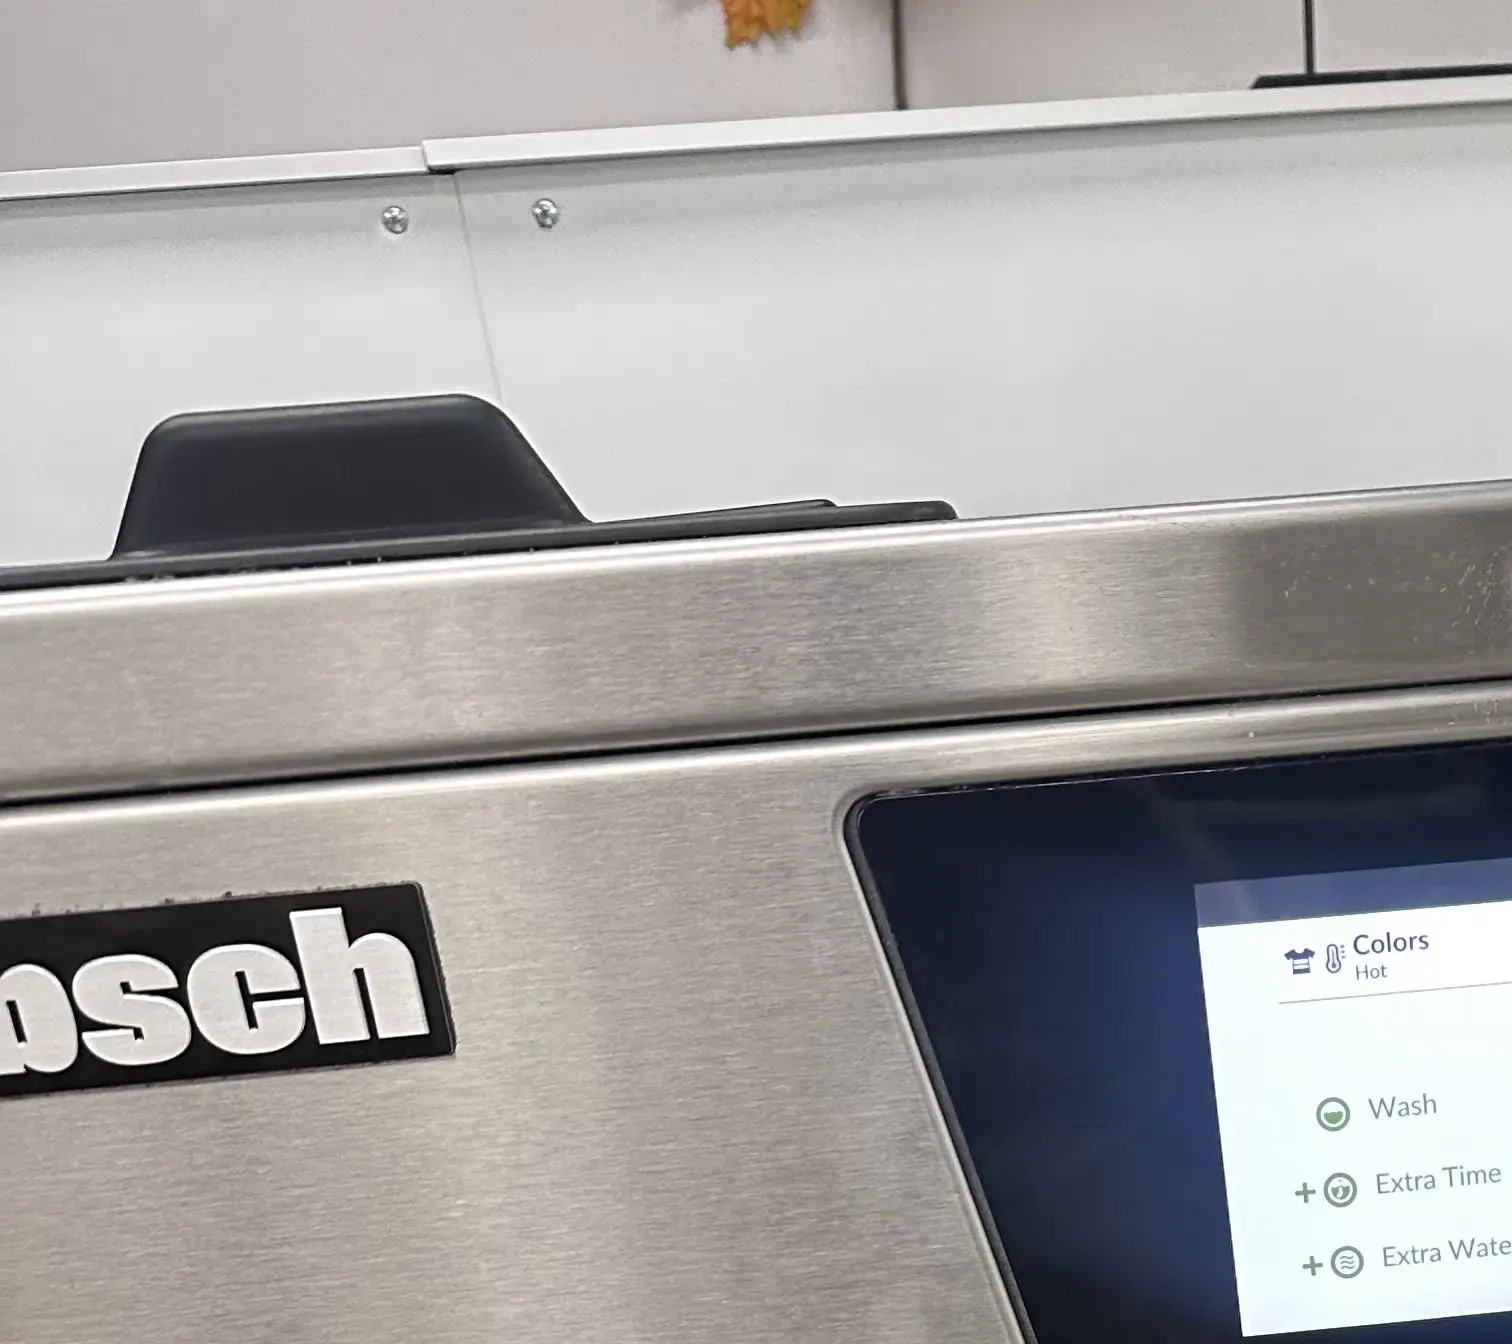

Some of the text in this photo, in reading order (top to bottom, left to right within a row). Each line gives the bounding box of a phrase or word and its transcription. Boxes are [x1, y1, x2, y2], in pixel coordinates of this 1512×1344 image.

[1353, 930, 1430, 956] Colors
[1355, 963, 1388, 981] Hot
[1368, 1092, 1438, 1119] Wash
[1376, 1164, 1502, 1195] Extra Time
[1382, 1244, 1442, 1268] Extra
